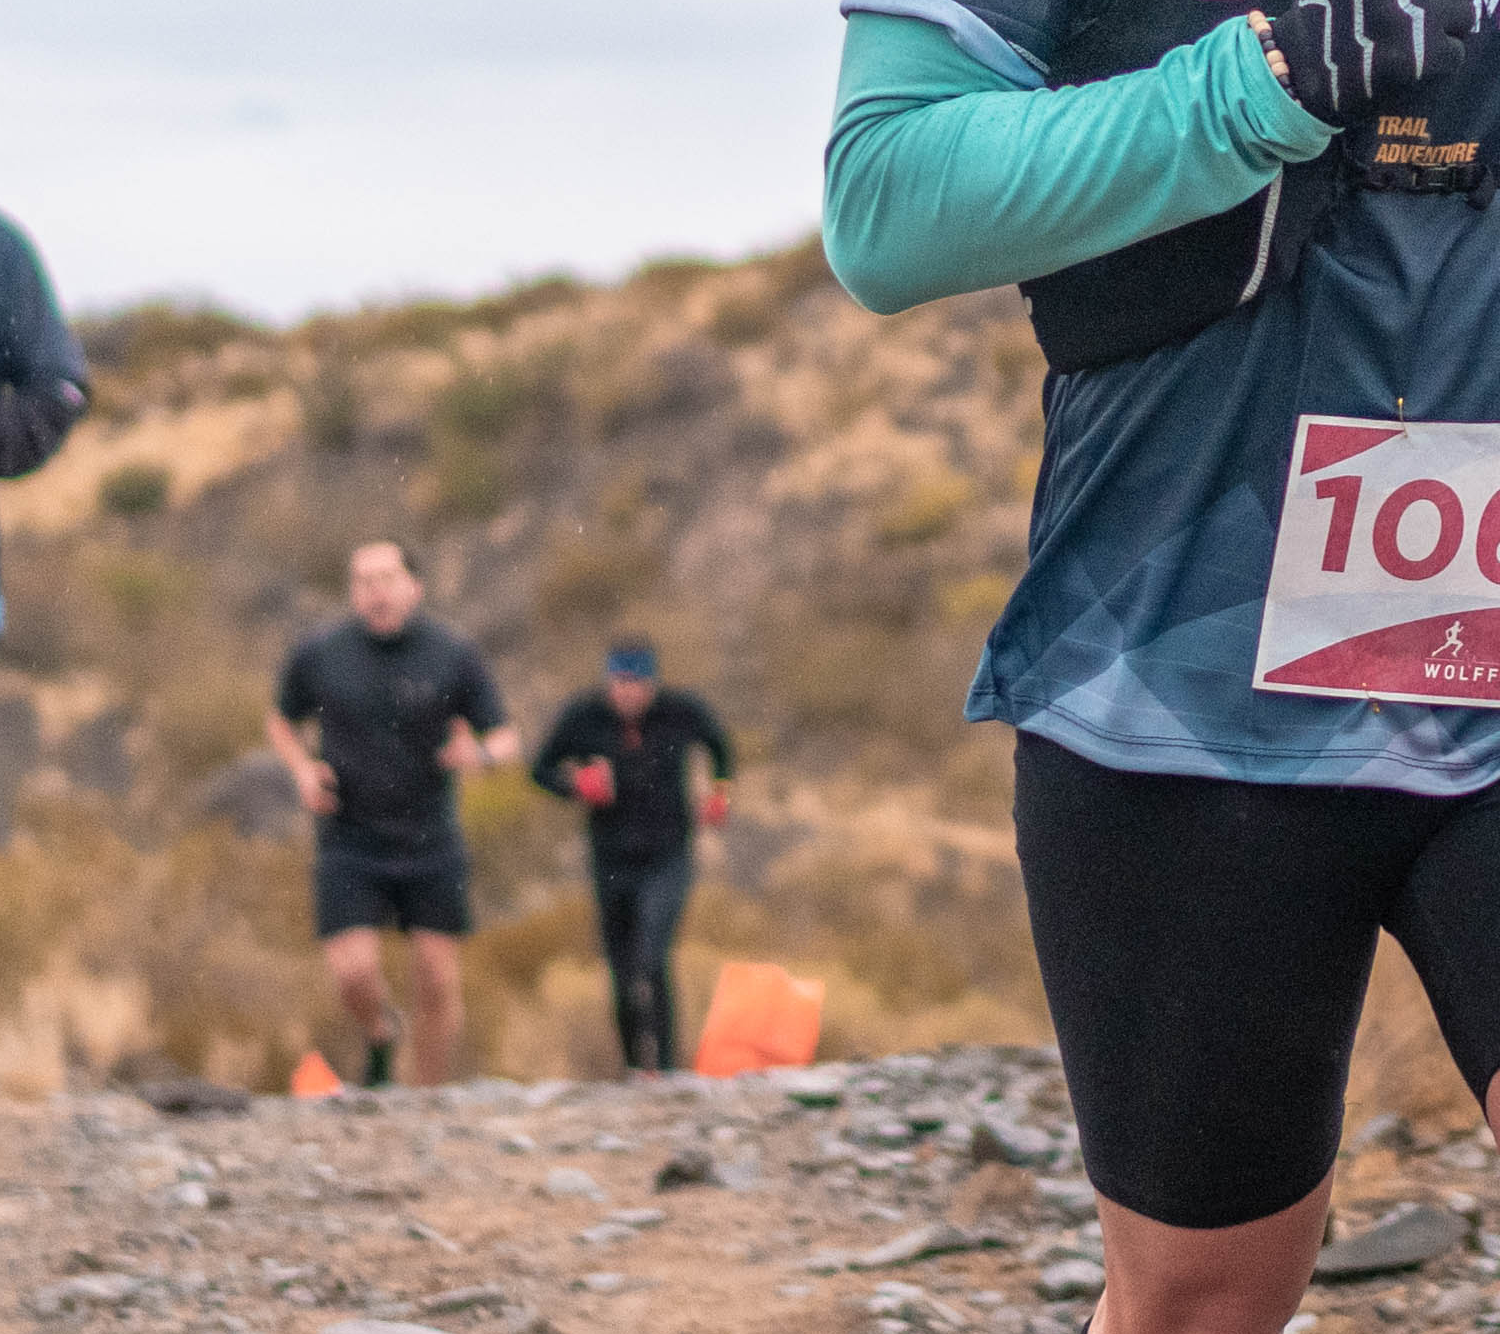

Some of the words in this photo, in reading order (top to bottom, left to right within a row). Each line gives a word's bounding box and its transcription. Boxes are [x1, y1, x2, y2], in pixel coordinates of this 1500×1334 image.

[1377, 116, 1431, 140] TRAIL
[1373, 141, 1480, 164] ADVENTURE
[1424, 662, 1500, 683] WOLFF
